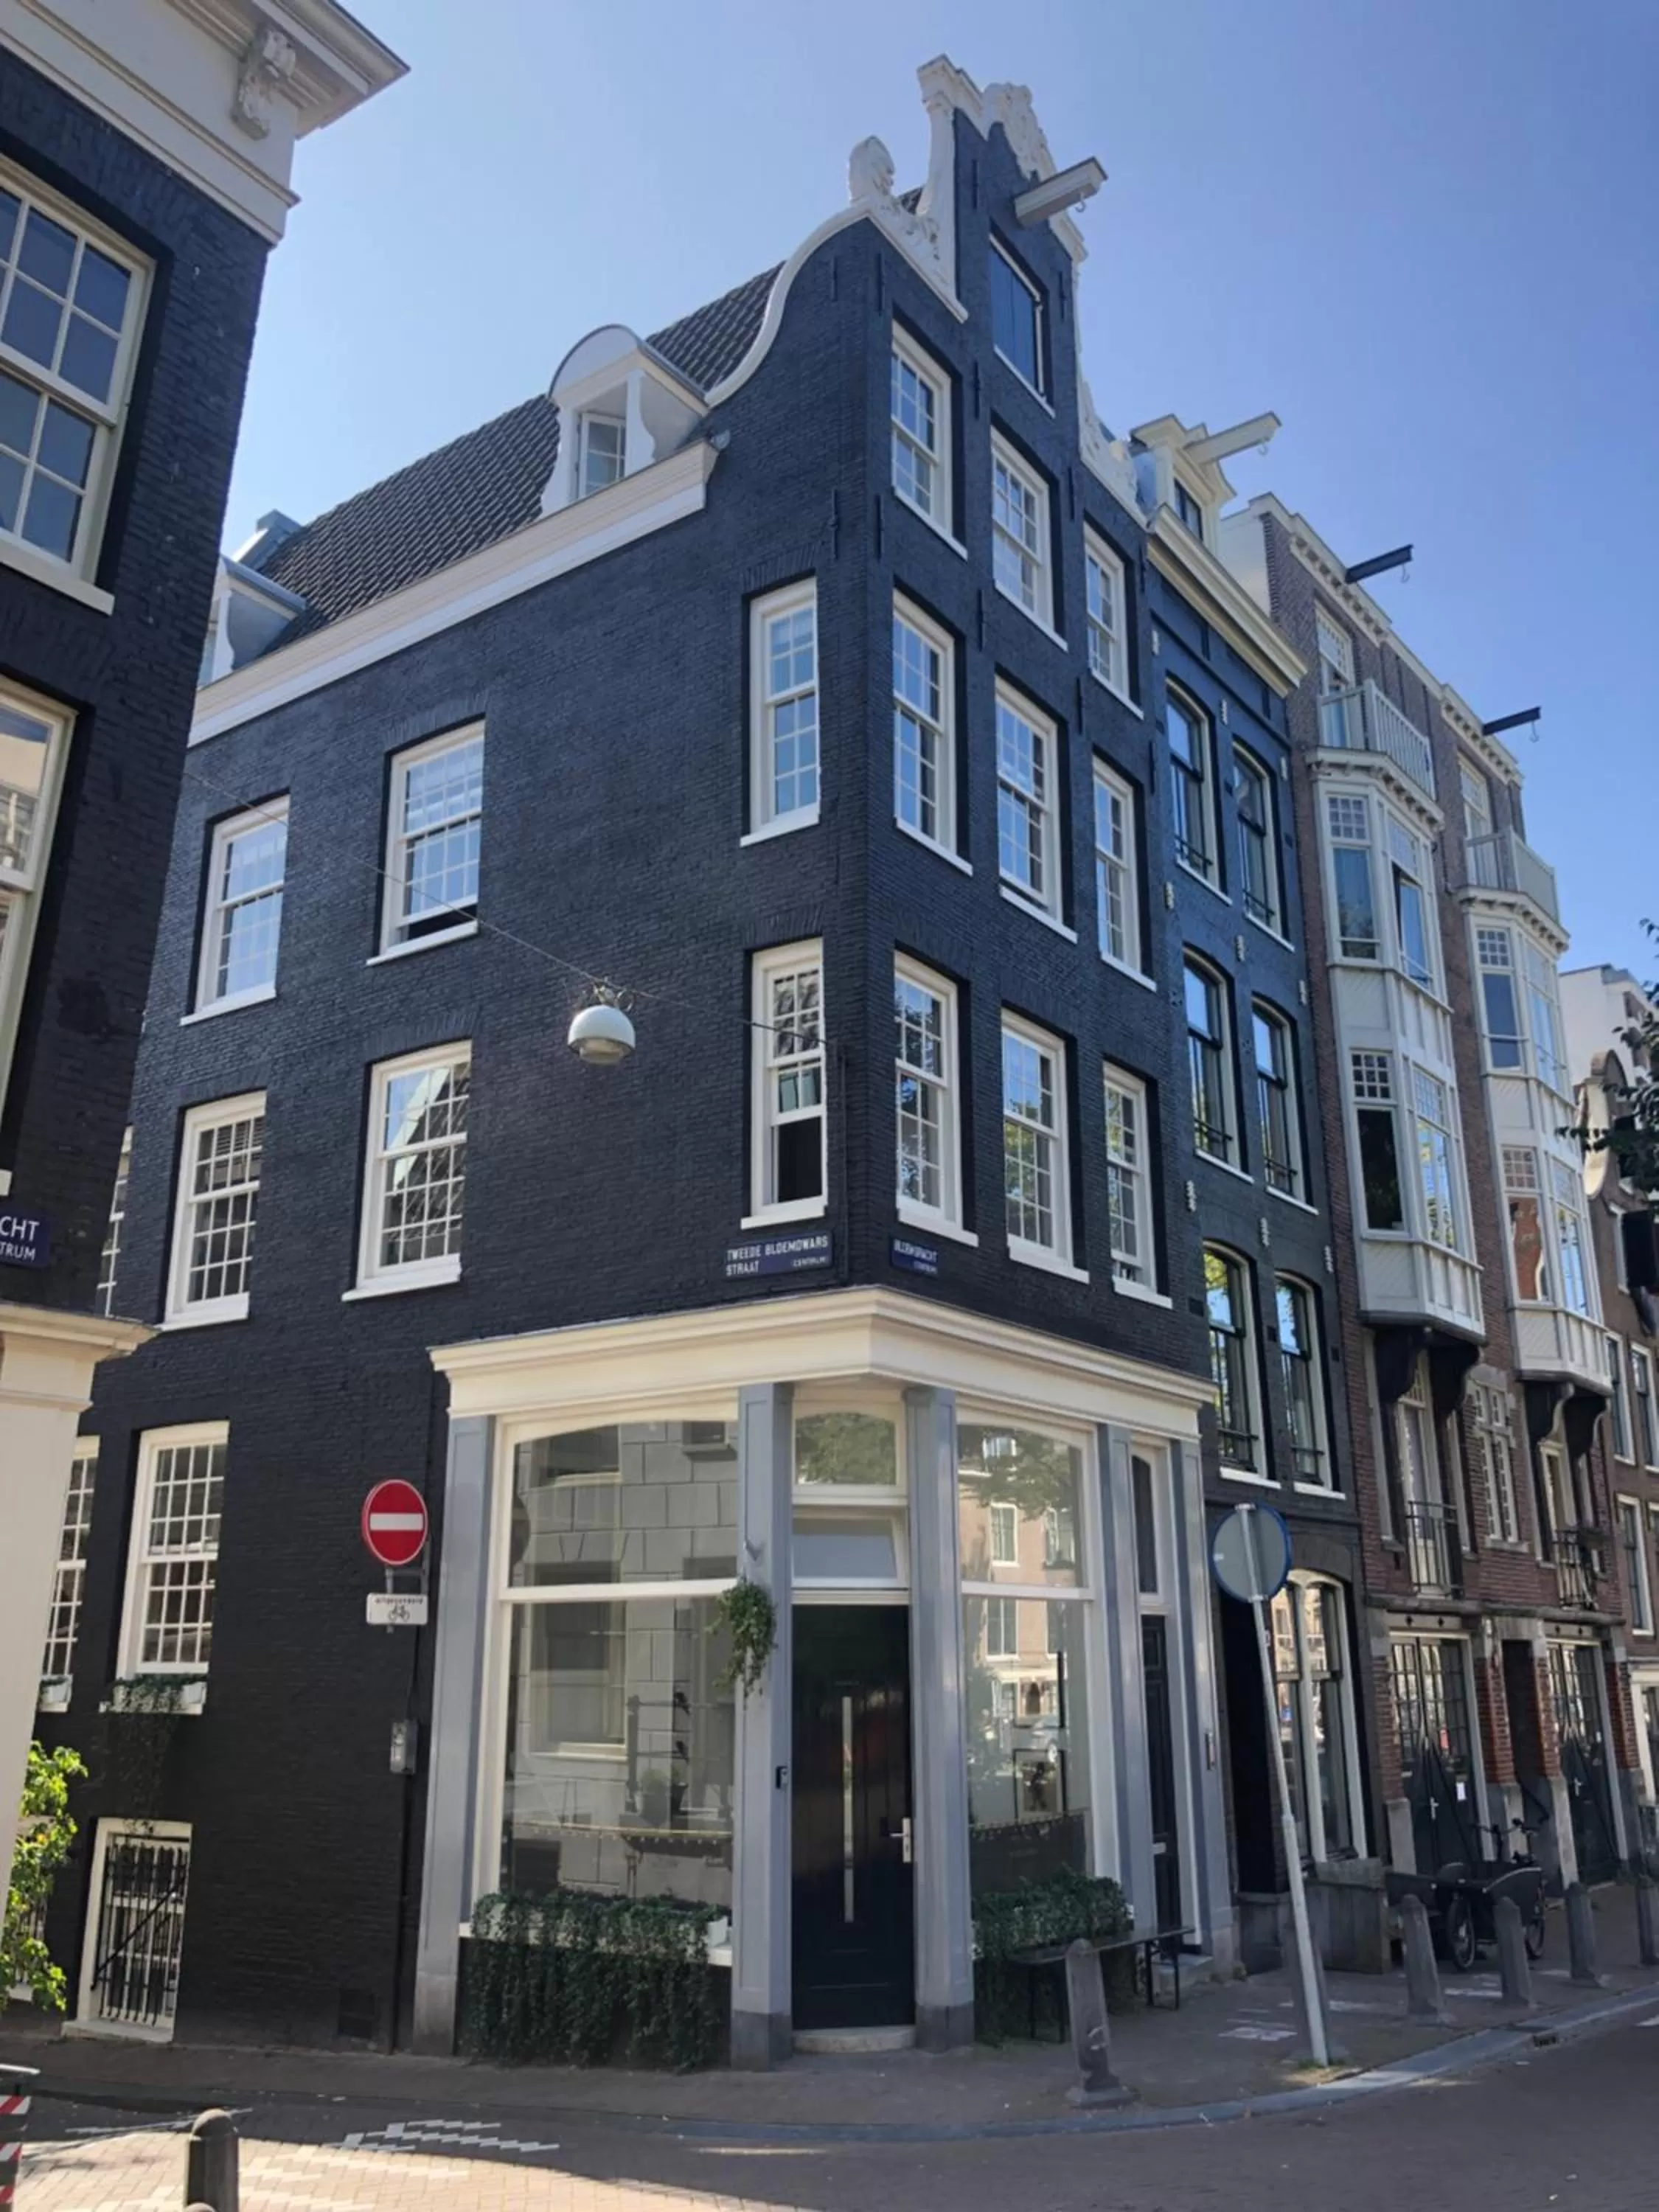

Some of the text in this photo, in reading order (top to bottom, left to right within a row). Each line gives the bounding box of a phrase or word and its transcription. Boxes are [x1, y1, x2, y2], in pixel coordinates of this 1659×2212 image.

[727, 1236, 828, 1261] TWEEDE BLOEMDWARS
[726, 1260, 759, 1276] STRAAT
